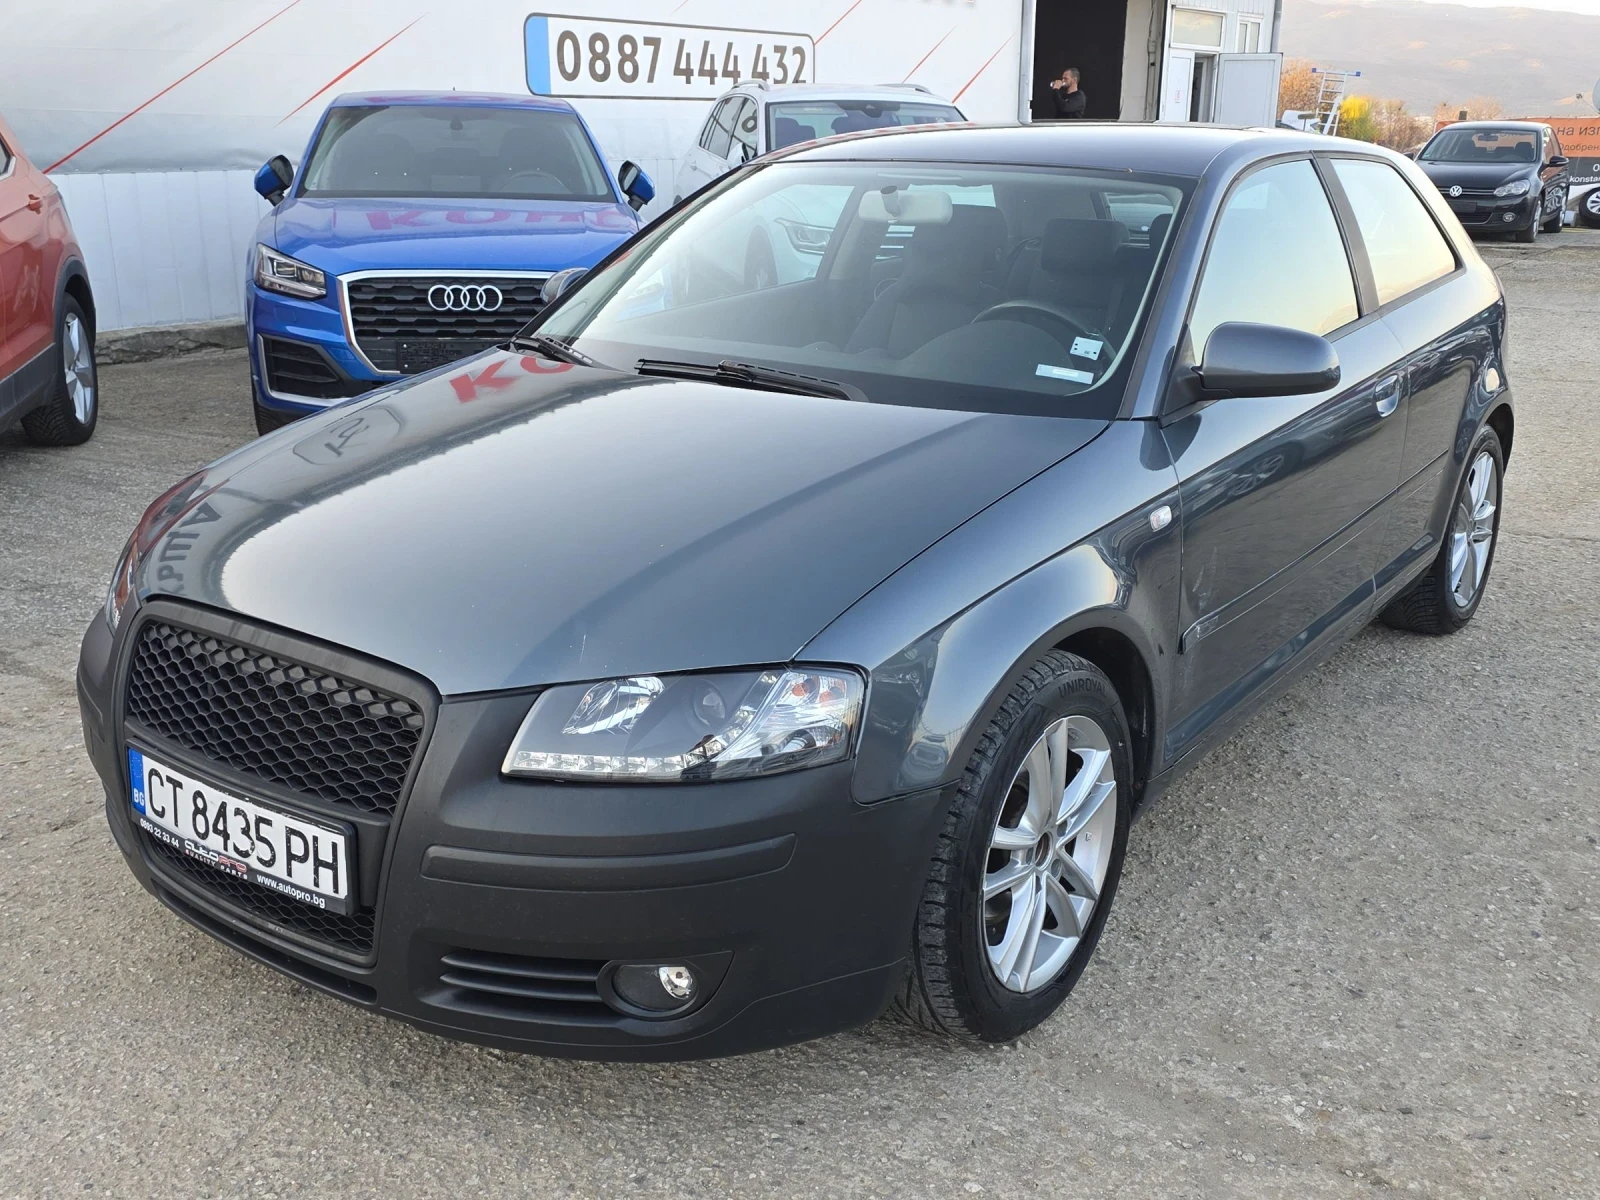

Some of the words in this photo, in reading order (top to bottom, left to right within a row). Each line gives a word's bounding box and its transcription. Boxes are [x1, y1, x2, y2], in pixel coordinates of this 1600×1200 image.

[556, 29, 662, 84] 0887
[673, 38, 742, 86] 444
[751, 43, 807, 86] 432
[1557, 126, 1575, 136] на
[1569, 175, 1600, 183] konsta
[1057, 677, 1106, 699] UNIROYAL
[133, 788, 145, 807] BG
[148, 767, 183, 828] CT
[192, 790, 277, 868] 8435
[285, 825, 339, 895] PH
[256, 873, 326, 909] www.autopro.bg
